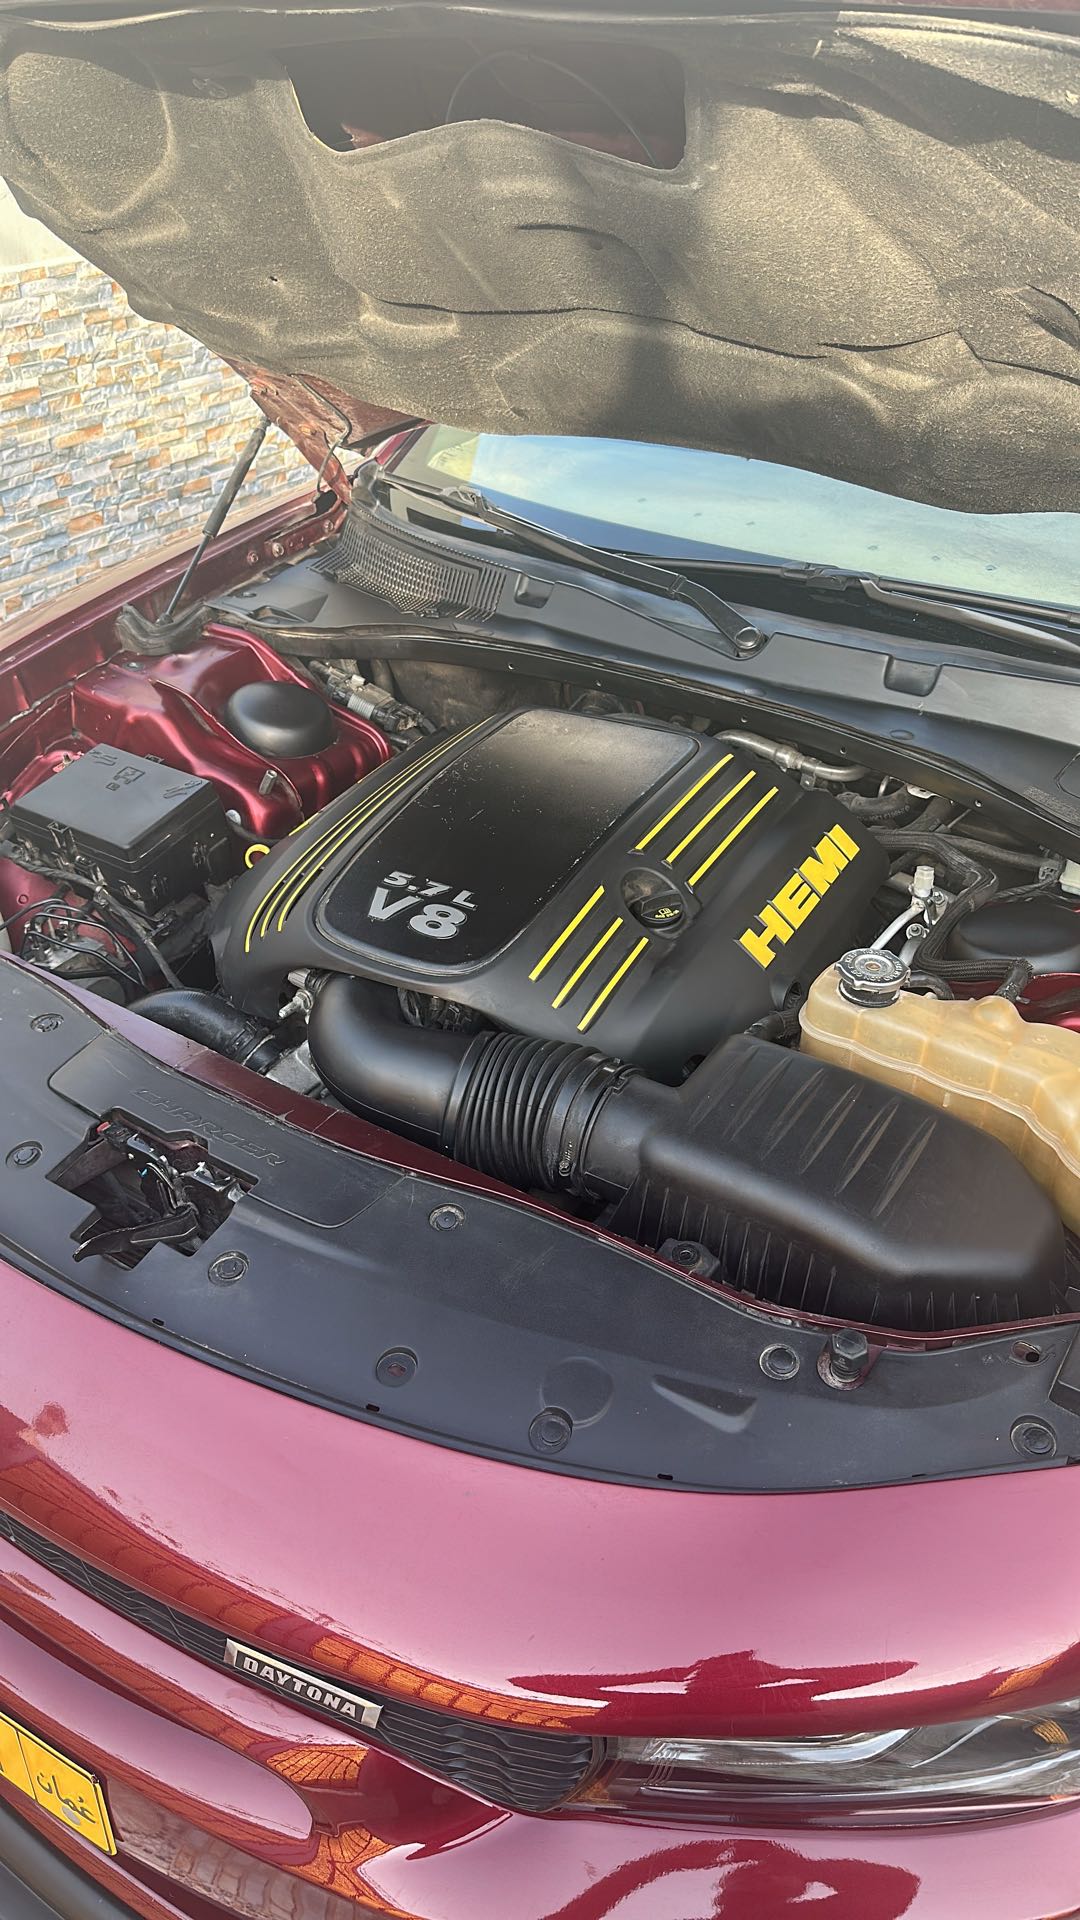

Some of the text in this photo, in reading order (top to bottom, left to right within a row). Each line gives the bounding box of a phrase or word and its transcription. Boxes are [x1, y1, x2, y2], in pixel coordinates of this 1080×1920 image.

[367, 886, 467, 939] V8
[736, 823, 861, 969] HEMI
[131, 1089, 286, 1166] CHARGER
[243, 1656, 357, 1719] DAYTONA
